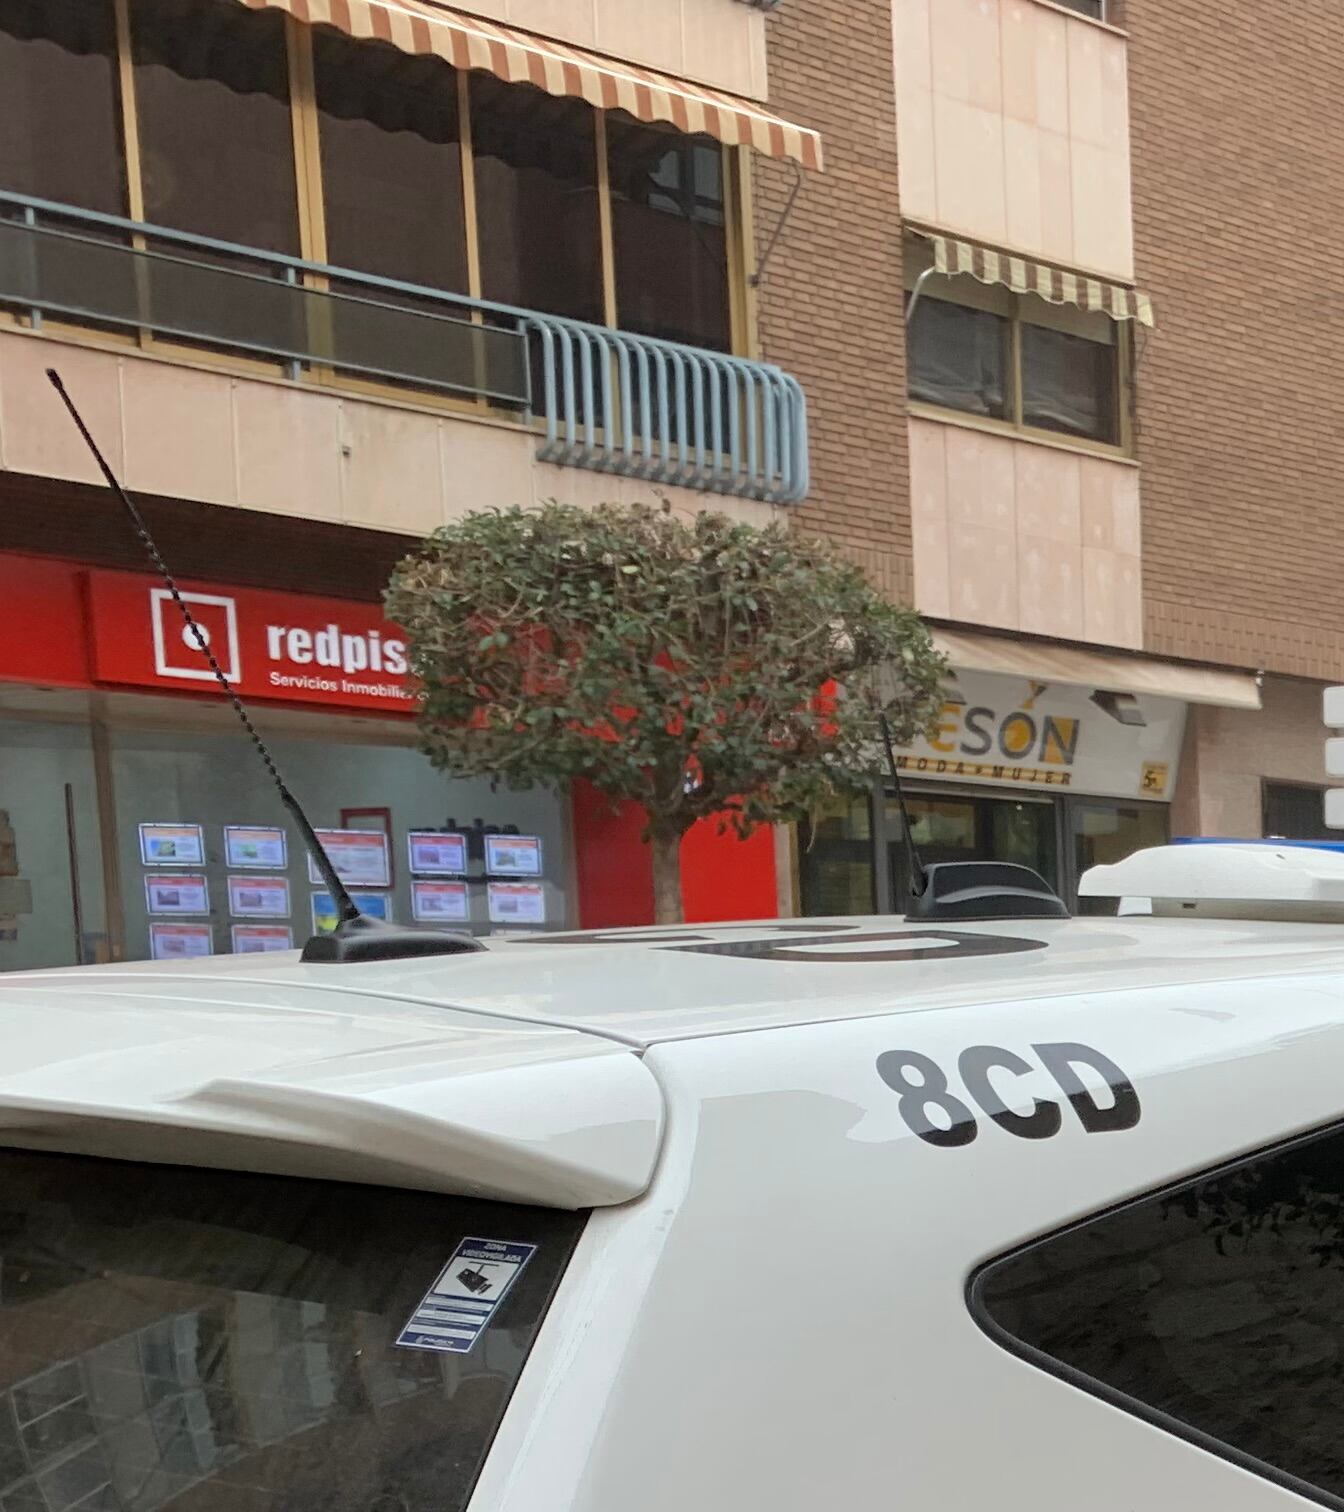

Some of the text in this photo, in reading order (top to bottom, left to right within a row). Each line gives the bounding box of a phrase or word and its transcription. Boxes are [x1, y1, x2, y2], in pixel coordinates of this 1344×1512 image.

[267, 624, 408, 674] redpis
[269, 671, 338, 692] Servicios
[896, 755, 1072, 785] MODA MUJER
[876, 1042, 1141, 1147] 8CD
